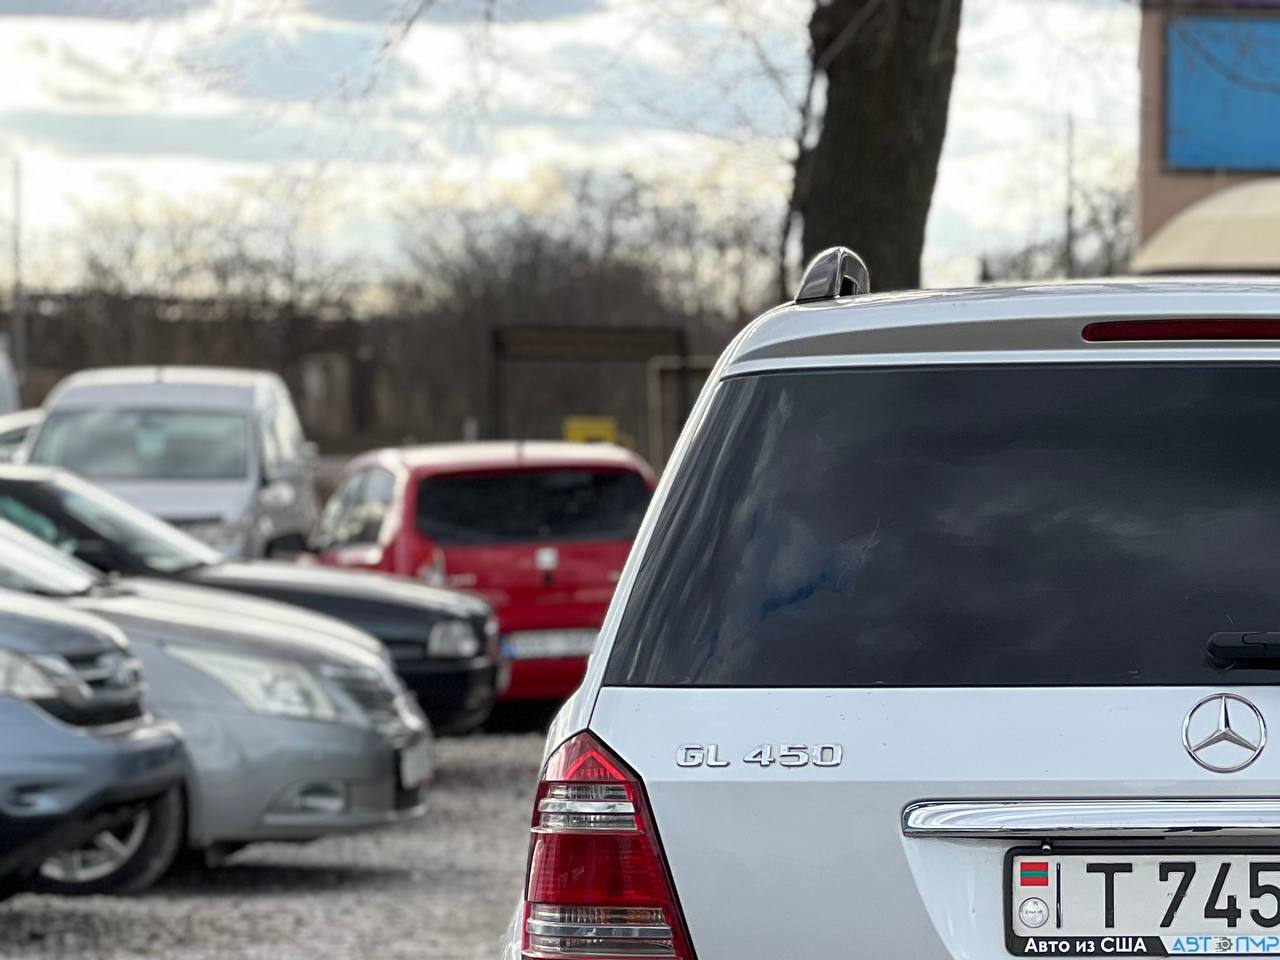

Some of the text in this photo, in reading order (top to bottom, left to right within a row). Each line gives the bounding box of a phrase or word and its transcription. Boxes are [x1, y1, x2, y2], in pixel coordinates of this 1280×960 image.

[676, 744, 843, 767] GL 450
[1024, 937, 1147, 953] Авто из США
